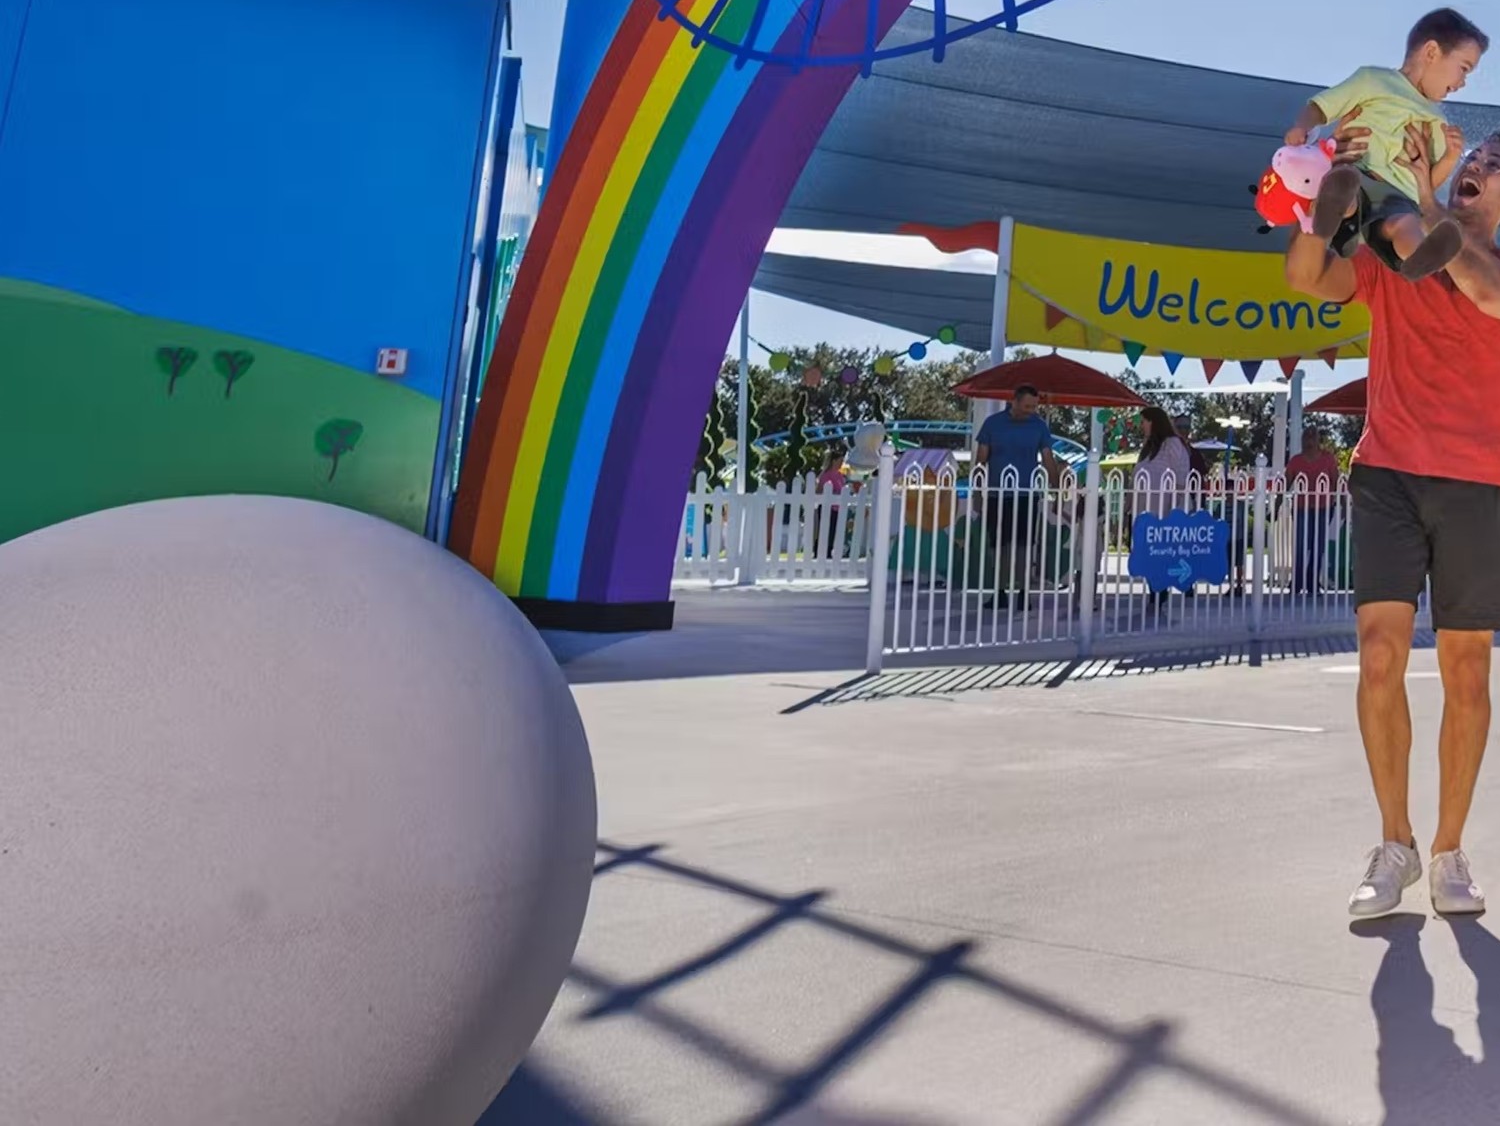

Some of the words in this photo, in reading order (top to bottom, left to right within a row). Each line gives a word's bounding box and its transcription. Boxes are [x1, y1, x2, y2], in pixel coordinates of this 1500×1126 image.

[1097, 259, 1342, 330] Welcome
[1146, 525, 1215, 544] ENTRANCE
[1149, 545, 1176, 558] Security
